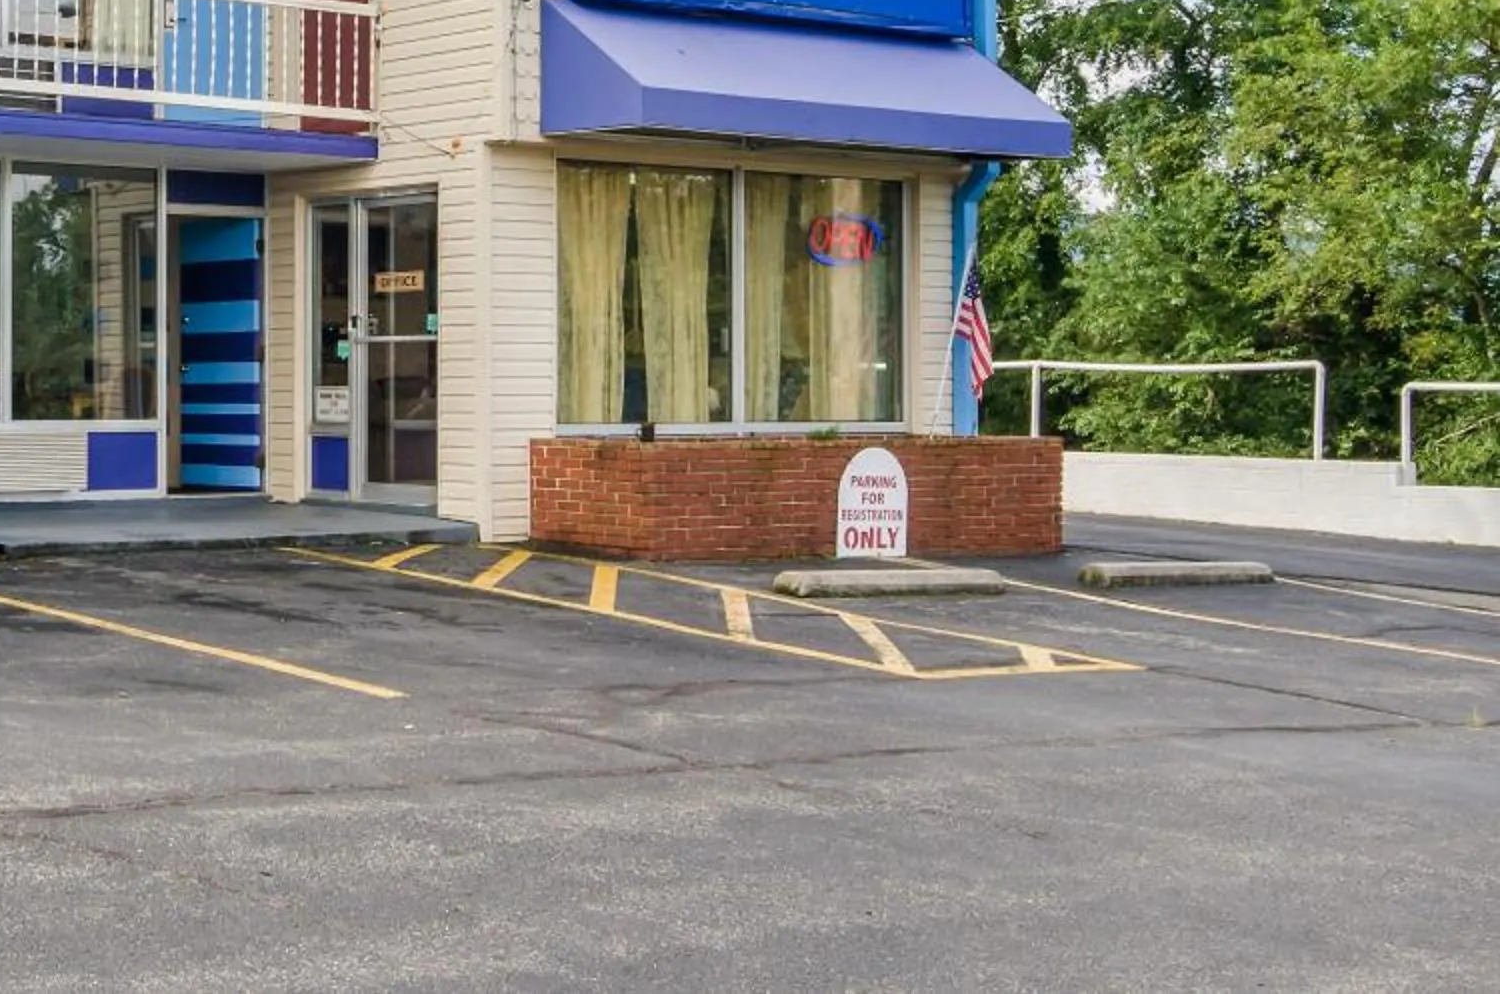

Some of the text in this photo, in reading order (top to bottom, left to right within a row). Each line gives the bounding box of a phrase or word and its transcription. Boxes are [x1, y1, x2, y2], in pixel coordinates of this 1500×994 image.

[809, 215, 873, 263] OPEN
[380, 275, 418, 287] OFFICE
[851, 475, 897, 489] PARKING
[861, 492, 885, 505] FOR
[841, 509, 903, 521] REGISTRATION
[843, 526, 900, 549] ONLY
